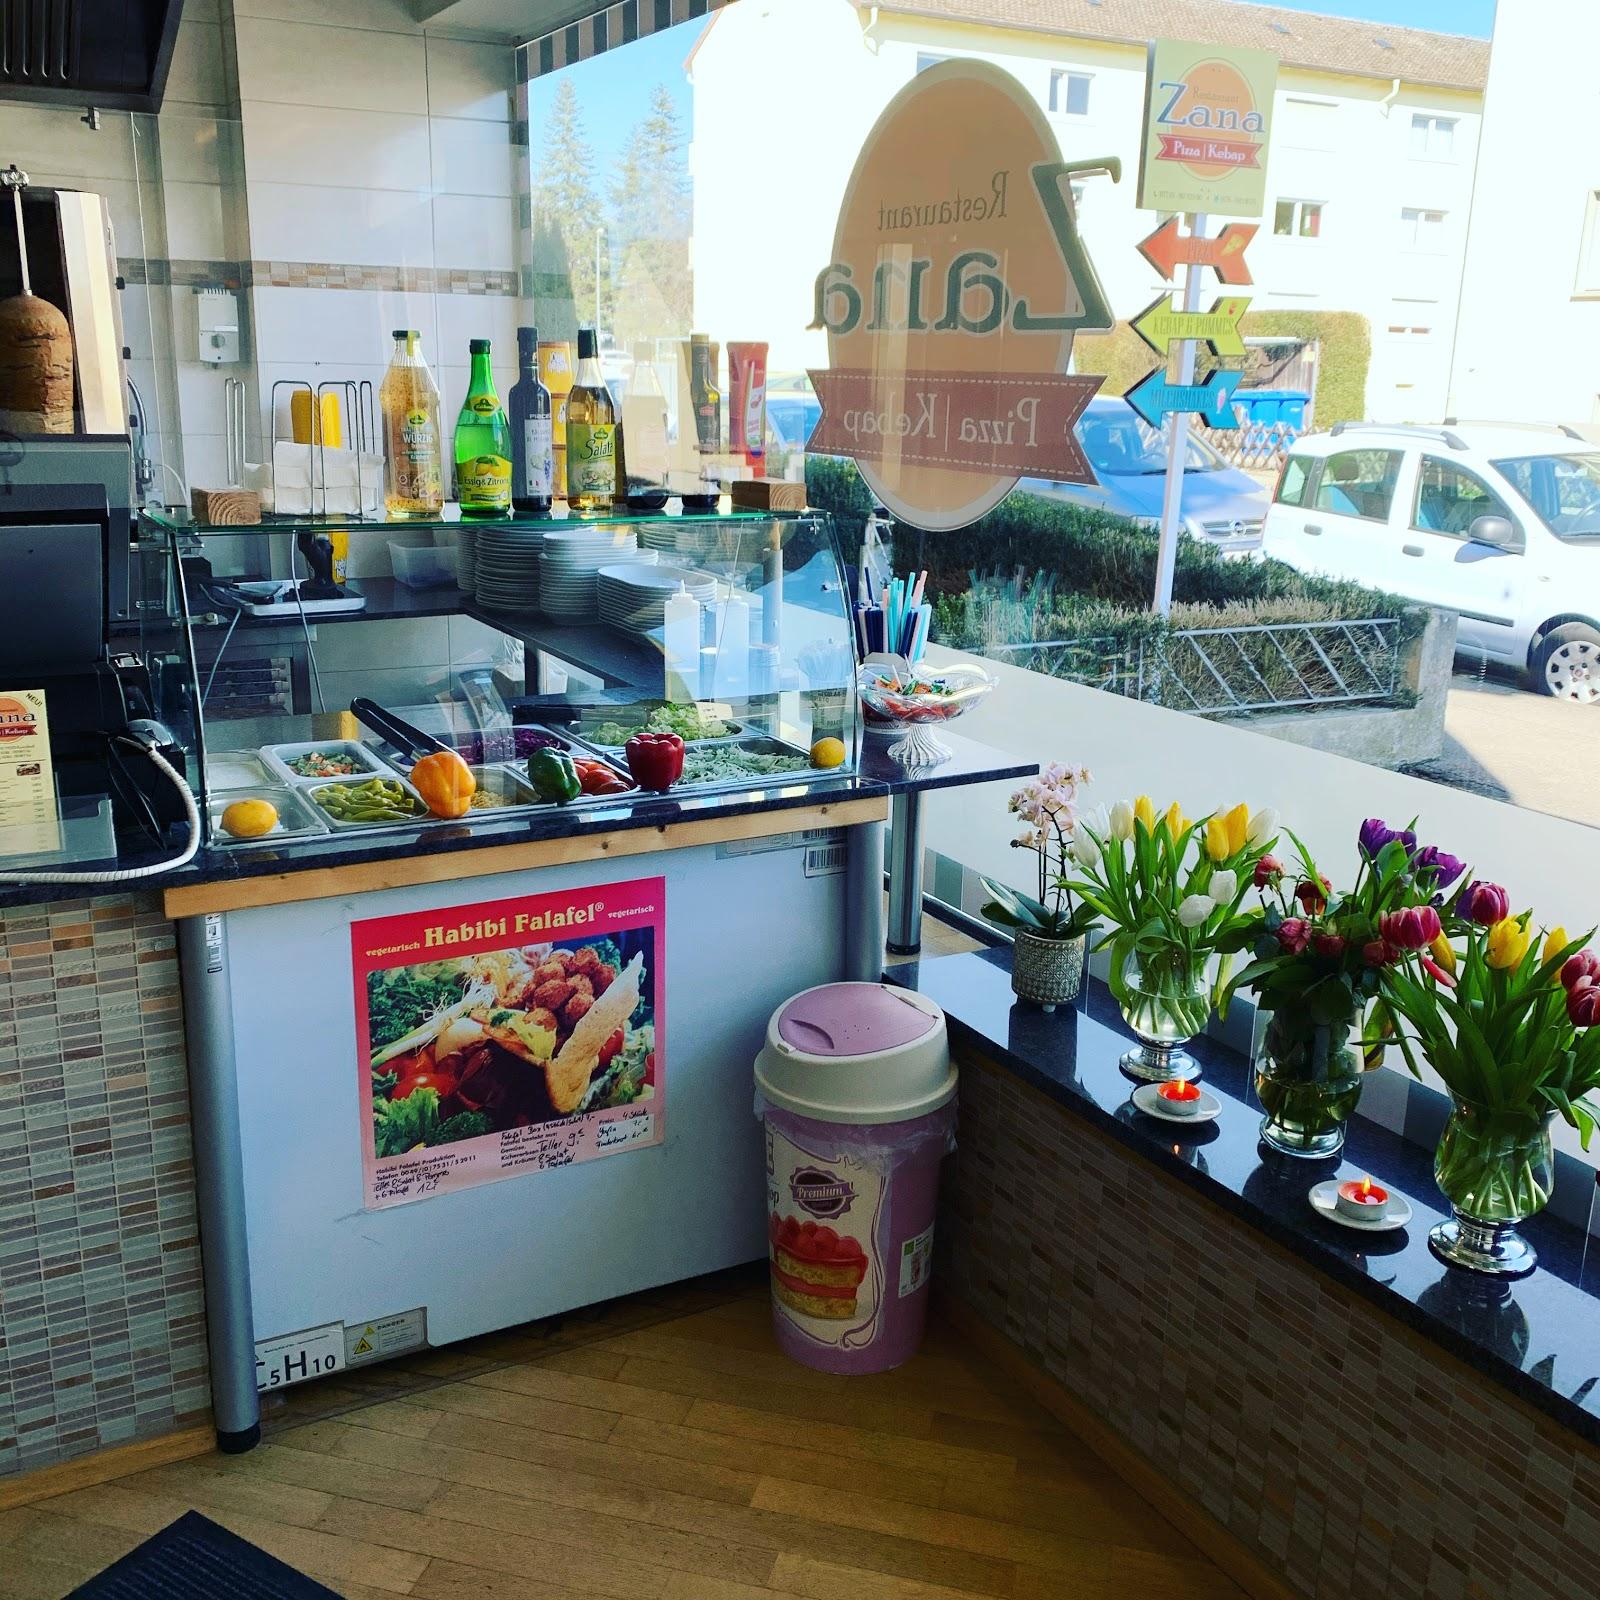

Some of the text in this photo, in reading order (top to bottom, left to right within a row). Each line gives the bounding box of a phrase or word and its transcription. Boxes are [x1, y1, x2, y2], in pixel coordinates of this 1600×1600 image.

[1157, 82, 1266, 134] Zana
[1173, 140, 1245, 162] Pizza Kebap
[366, 940, 421, 957] vegetarisch
[424, 917, 507, 948] Habibi
[607, 905, 655, 919] vegetarisch
[536, 1139, 562, 1153] Teller
[376, 1153, 456, 1175] Habibi Falafel Produktion
[377, 1173, 399, 1181] Telefon
[796, 1186, 843, 1199] Premium
